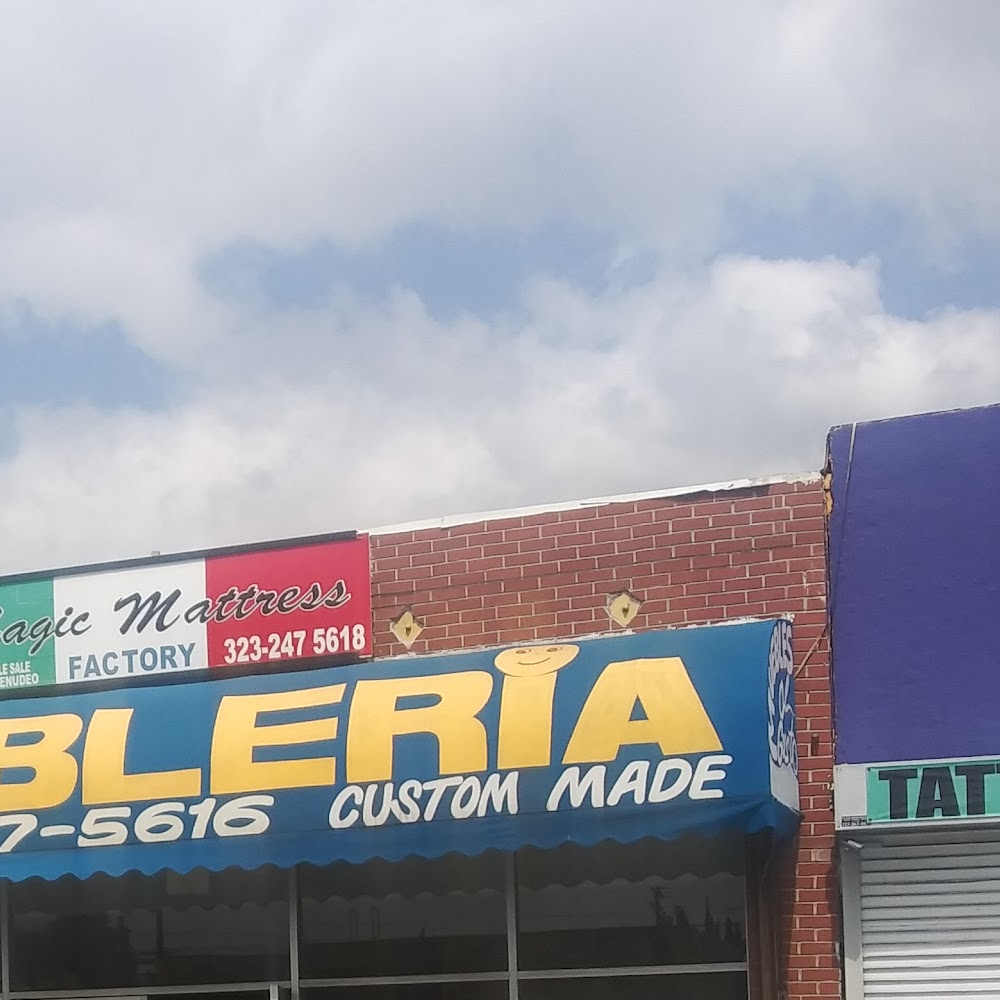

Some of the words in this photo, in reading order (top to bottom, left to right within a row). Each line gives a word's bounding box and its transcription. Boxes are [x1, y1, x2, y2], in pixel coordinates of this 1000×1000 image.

[114, 579, 351, 635] Mattress
[9, 661, 31, 674] SALE
[69, 643, 196, 679] FACTORY
[224, 631, 305, 664] 323-247
[312, 624, 366, 655] 5618
[328, 770, 519, 831] CUSTOM
[546, 755, 733, 812] MADE
[878, 763, 1000, 820] TAT
